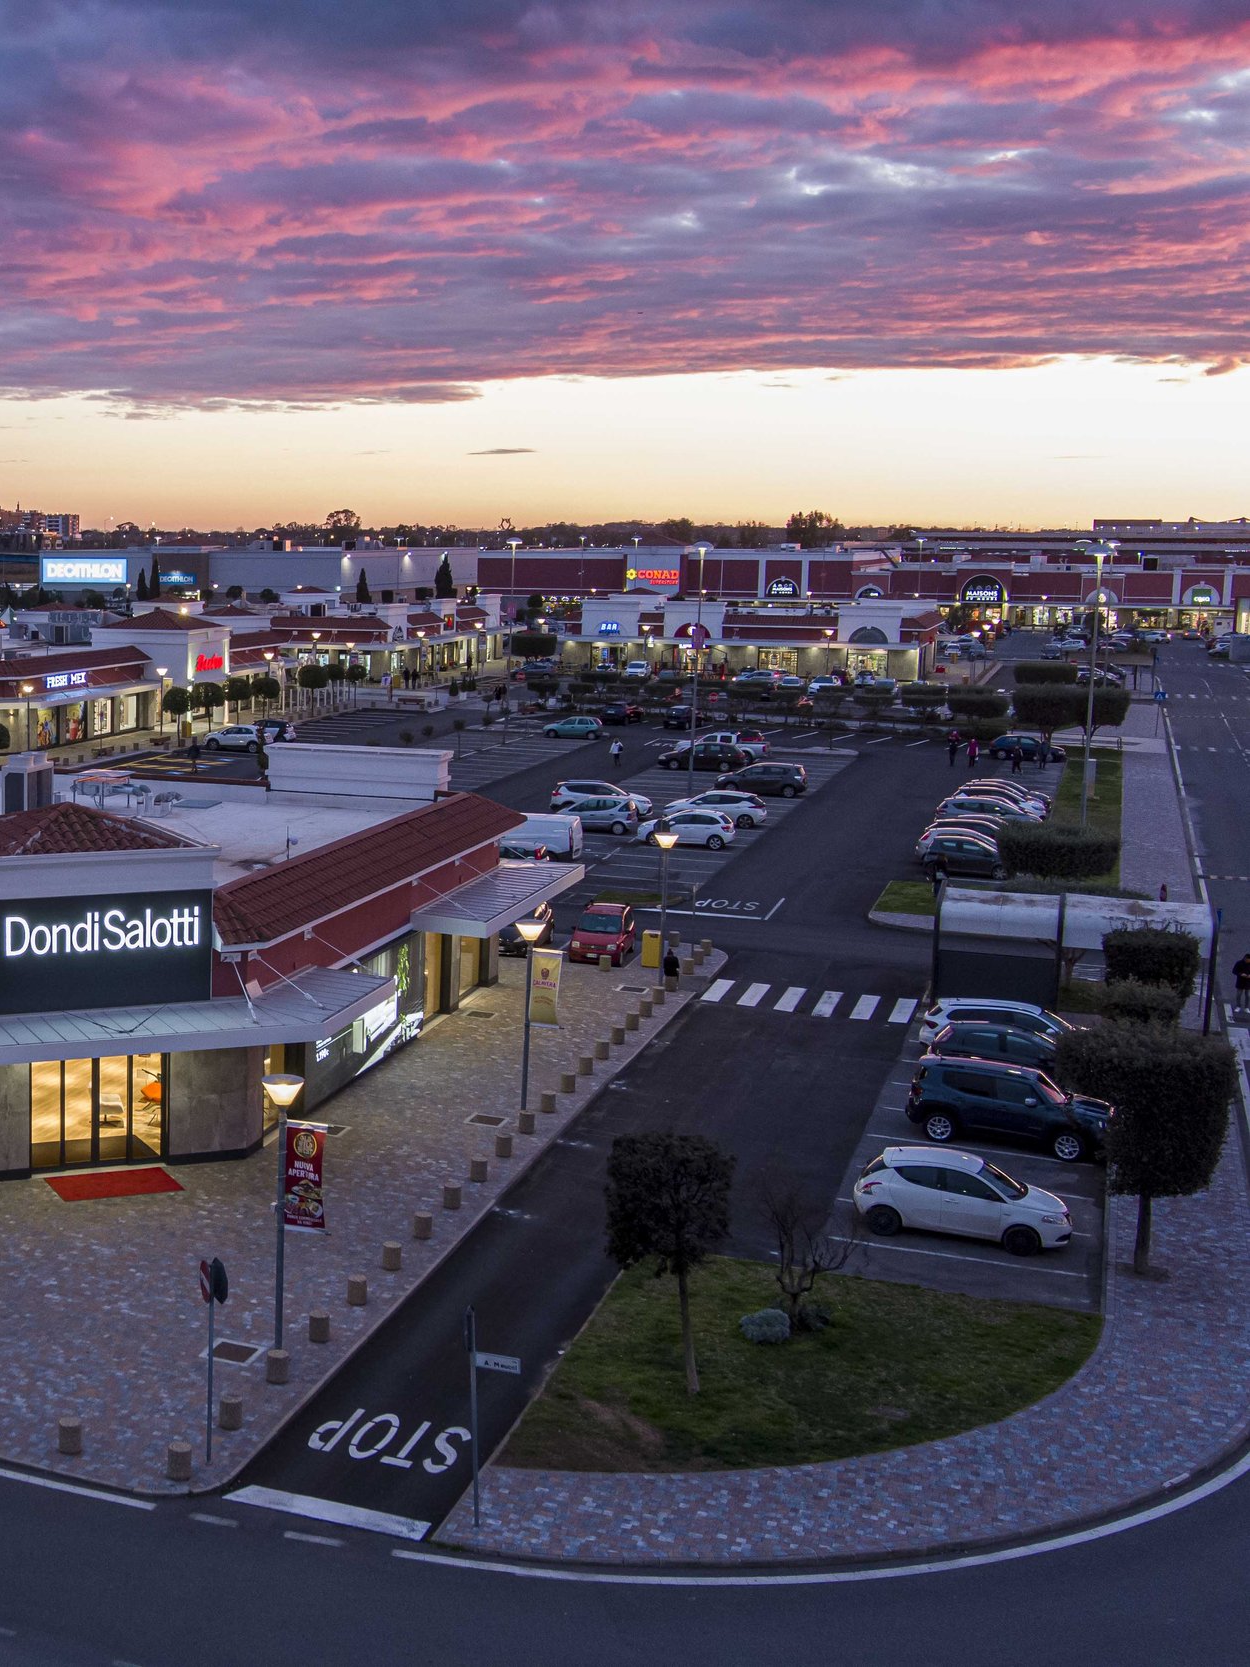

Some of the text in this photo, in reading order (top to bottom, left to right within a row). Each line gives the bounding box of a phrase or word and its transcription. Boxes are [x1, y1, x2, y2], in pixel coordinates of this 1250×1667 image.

[46, 563, 122, 578] DECATHLON
[637, 570, 679, 579] CONAD
[601, 623, 618, 631] BAR
[46, 672, 86, 688] FRESH MEX
[695, 899, 760, 911] STOP
[308, 1408, 472, 1474] STOP
